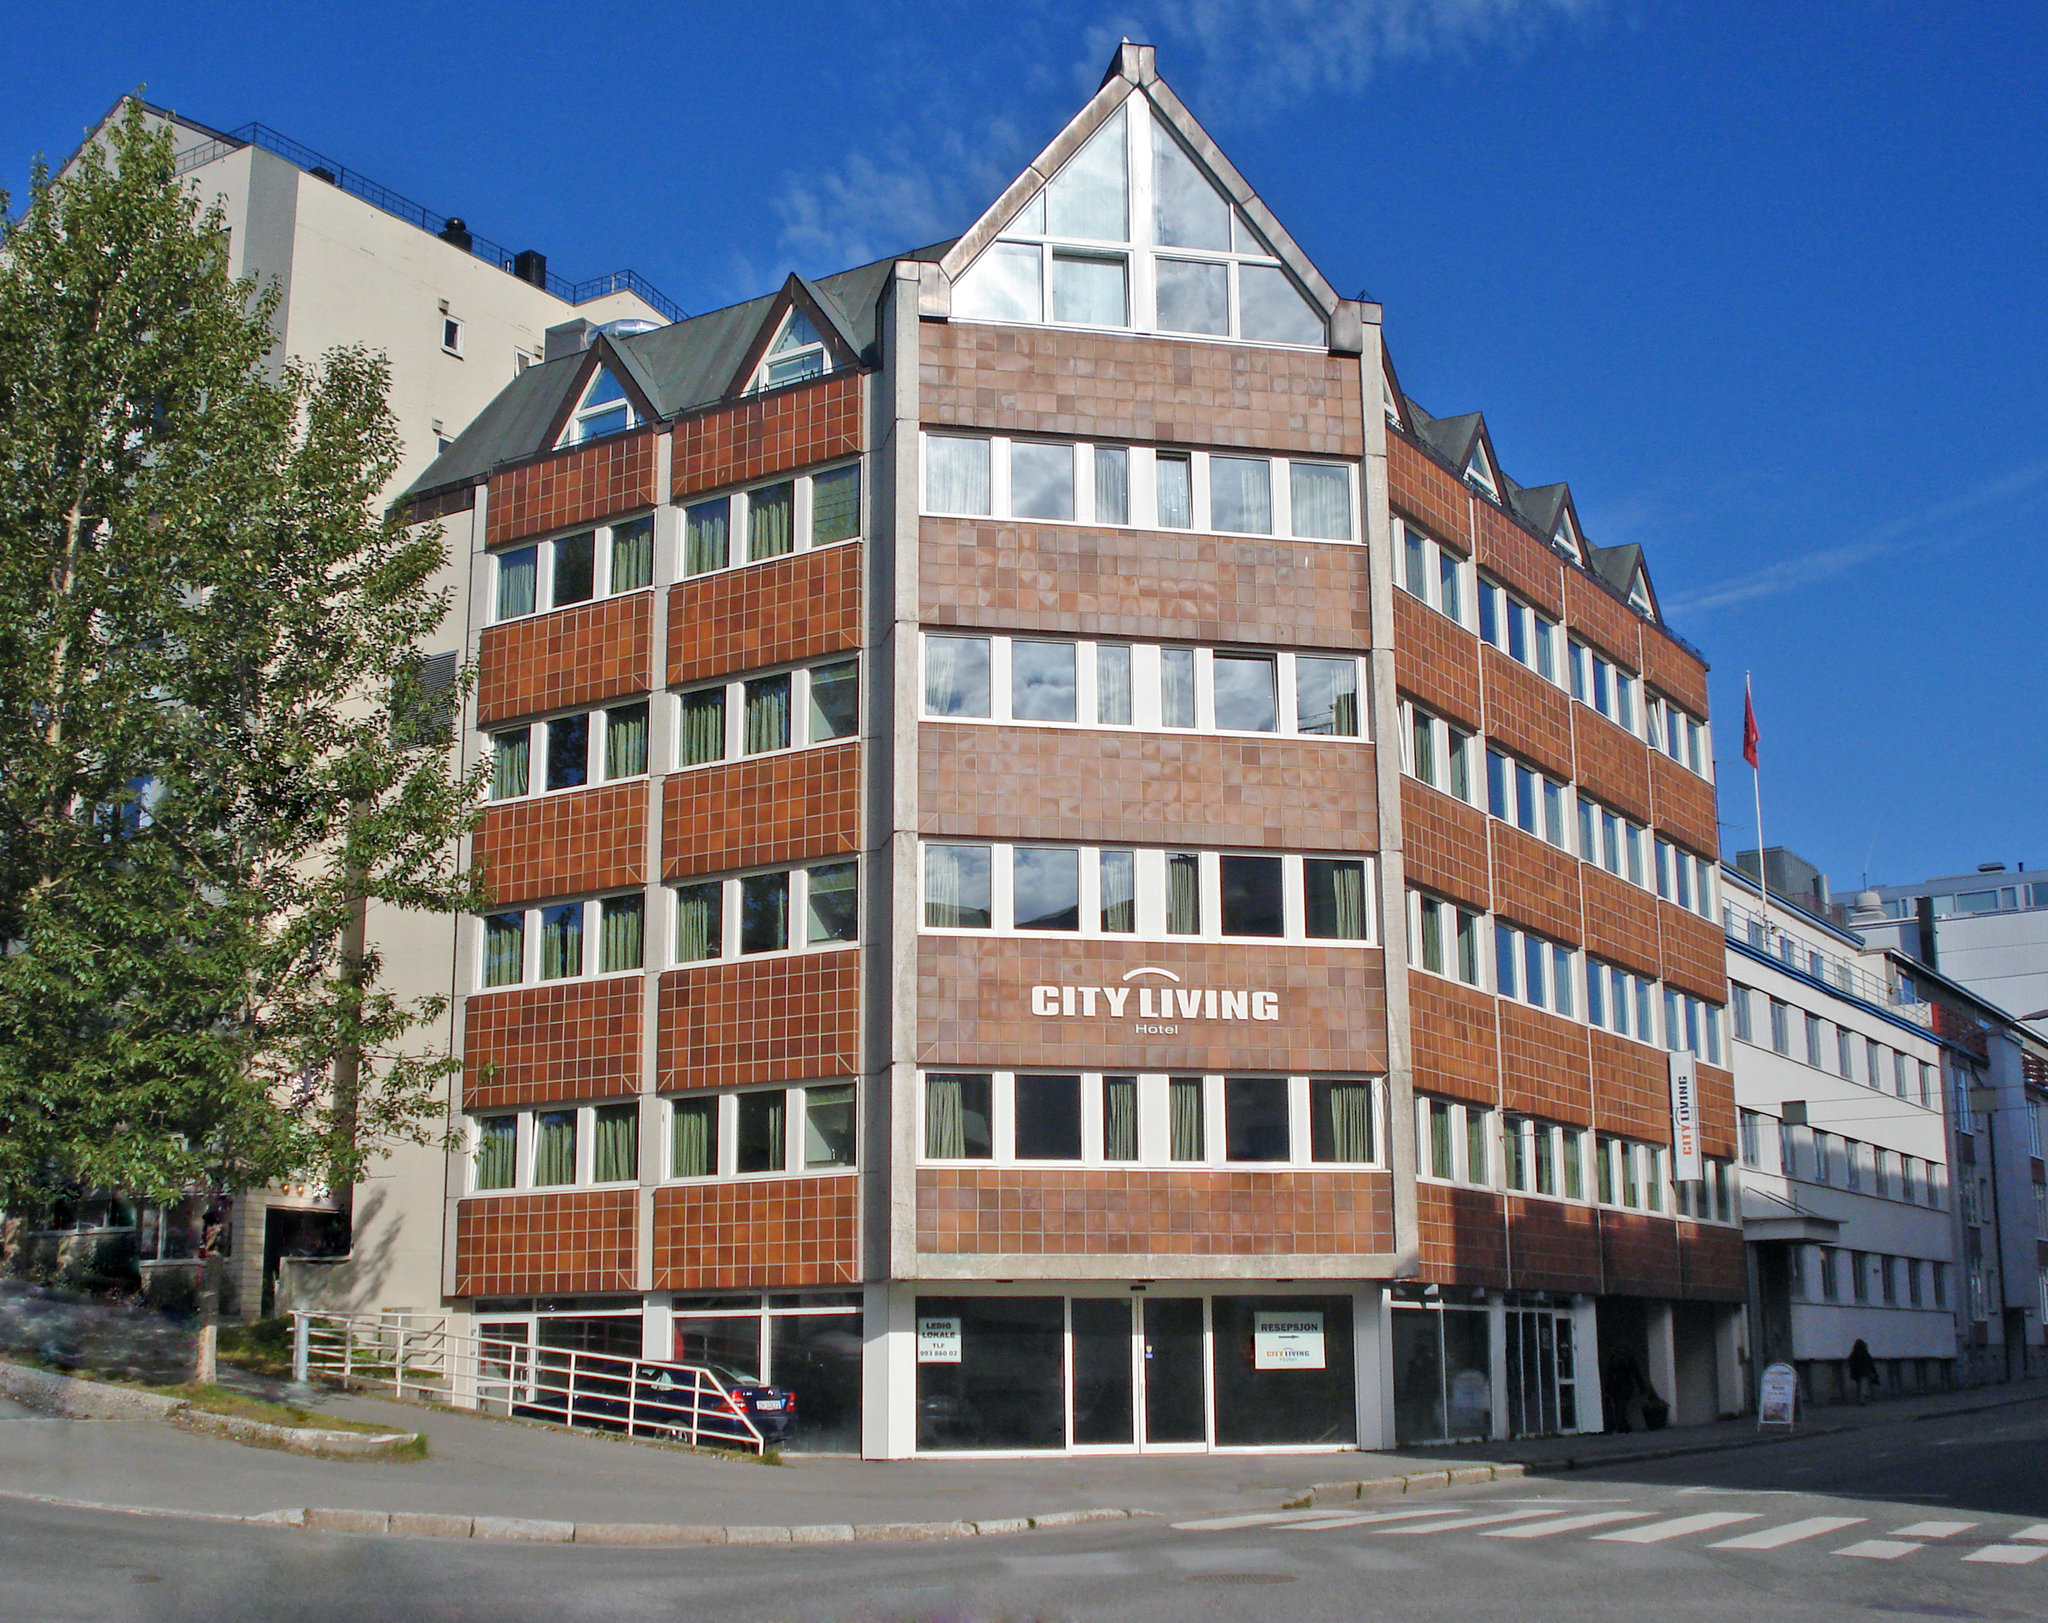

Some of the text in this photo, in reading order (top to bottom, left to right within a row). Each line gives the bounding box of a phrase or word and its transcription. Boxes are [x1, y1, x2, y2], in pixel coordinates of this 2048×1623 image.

[1031, 985, 1279, 1021] CITY LIVING
[1134, 1024, 1179, 1035] Hotel
[1678, 1075, 1692, 1155] CITY LIVING
[926, 1322, 952, 1330] LEDIG
[1261, 1323, 1318, 1332] RESEPSJON
[922, 1331, 956, 1339] LOKALE
